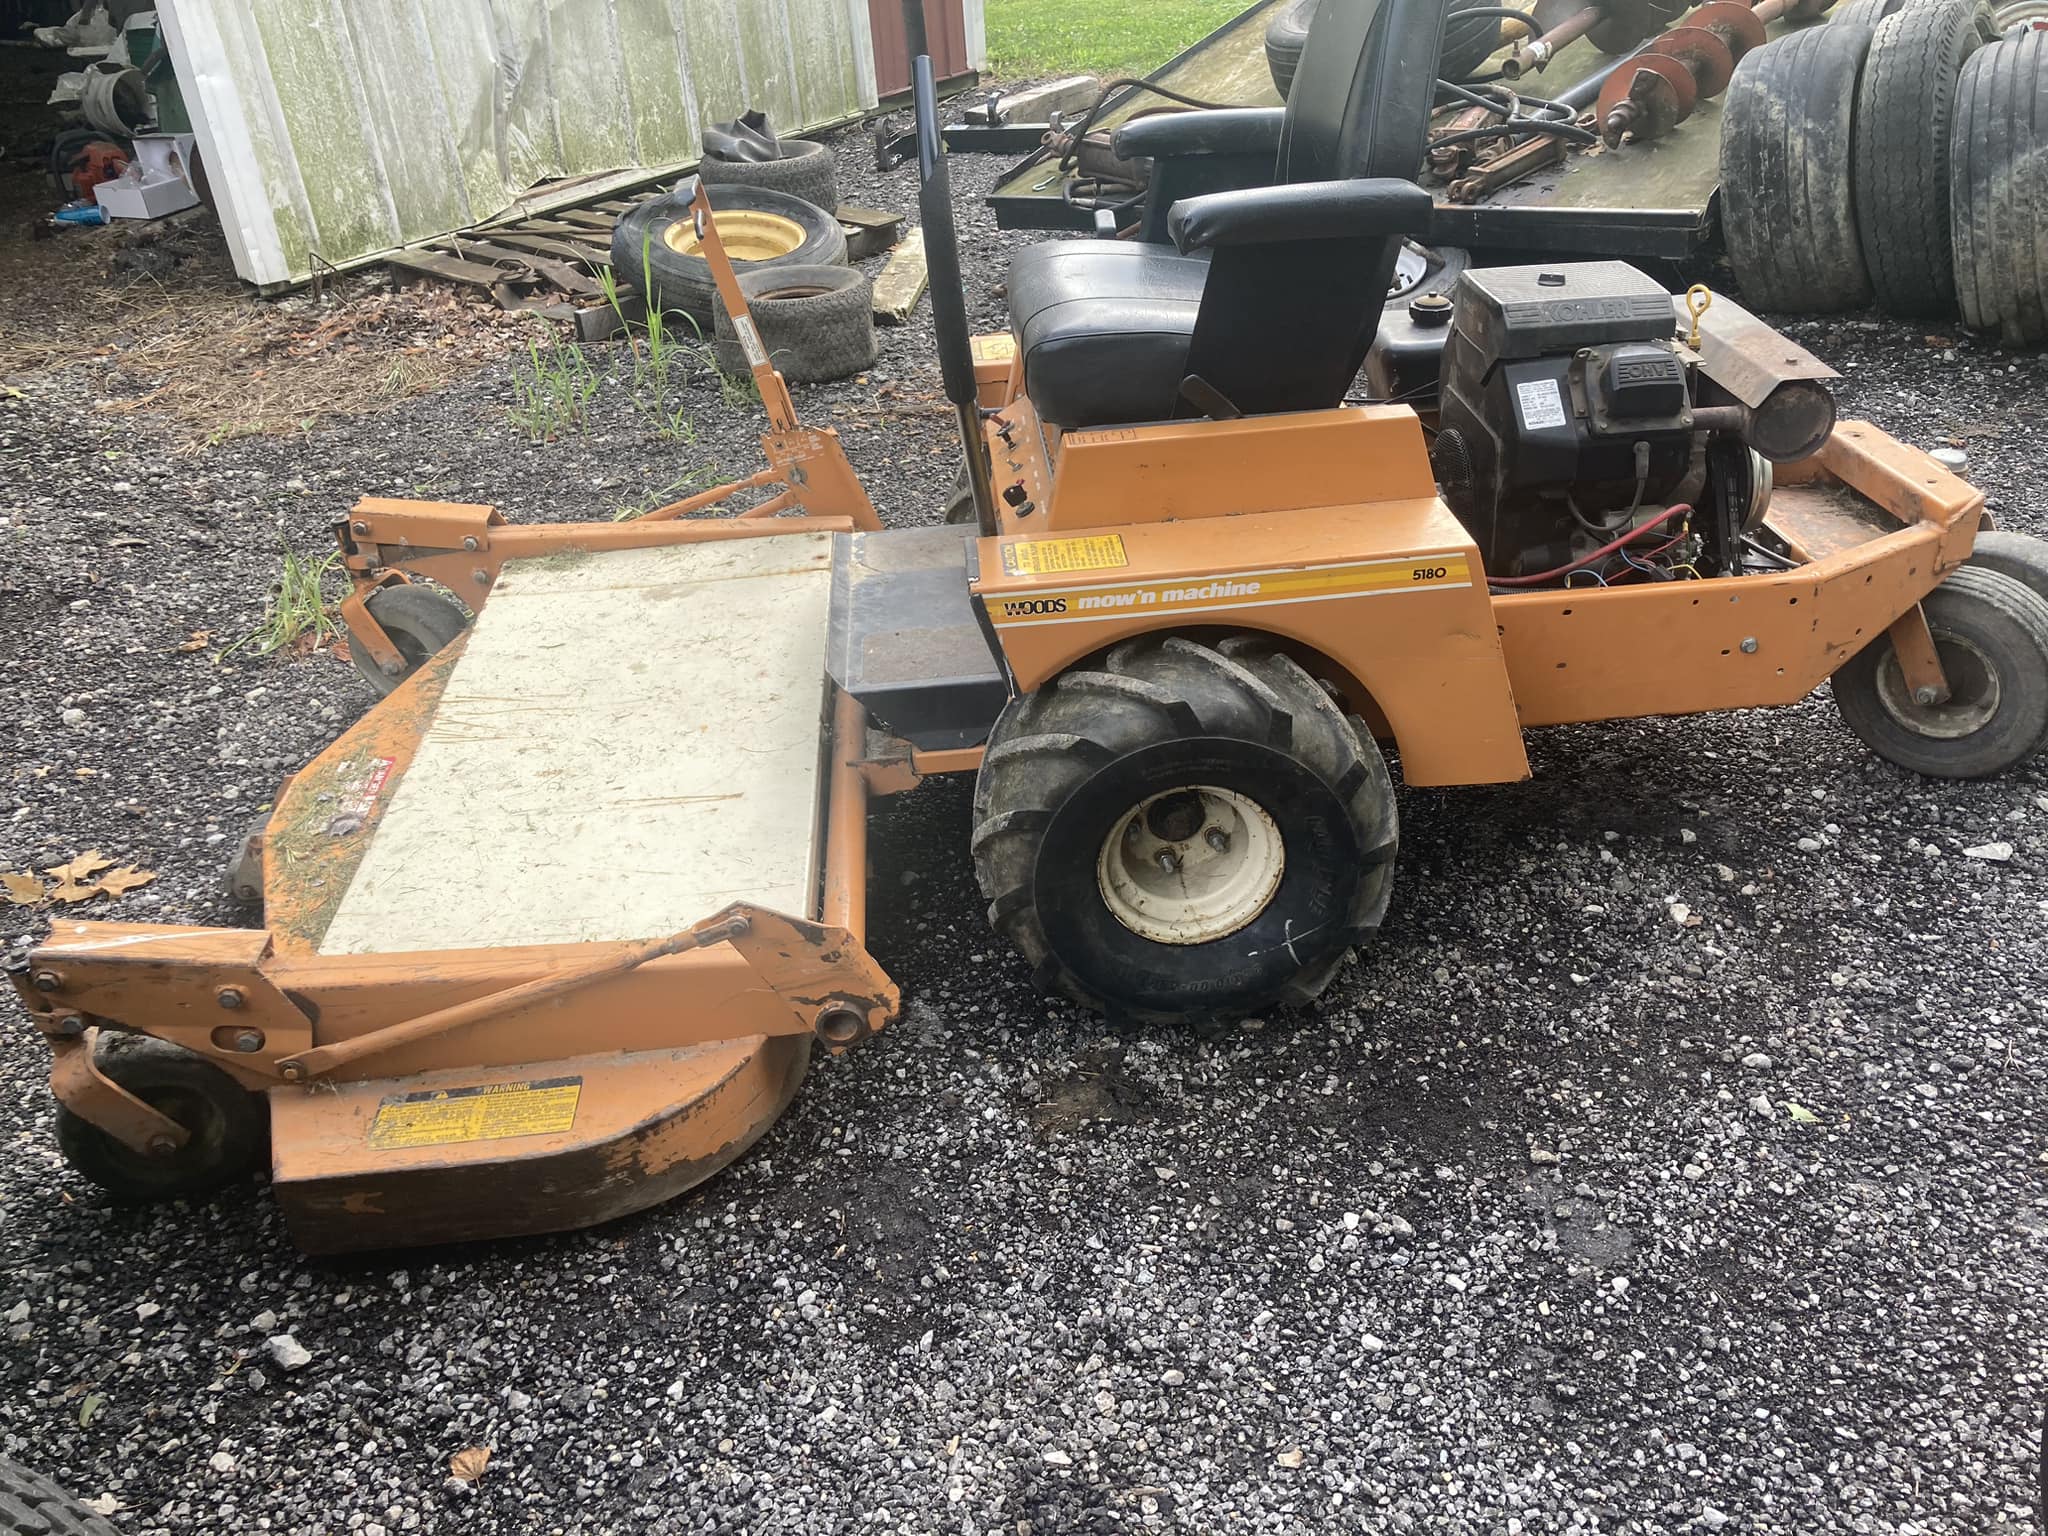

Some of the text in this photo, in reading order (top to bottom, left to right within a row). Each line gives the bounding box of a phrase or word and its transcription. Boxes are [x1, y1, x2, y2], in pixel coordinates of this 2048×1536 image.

[1539, 300, 1631, 322] KOHLER
[1004, 567, 1447, 616] WOODS mow'n machine 5180
[483, 1082, 530, 1095] WARNING
